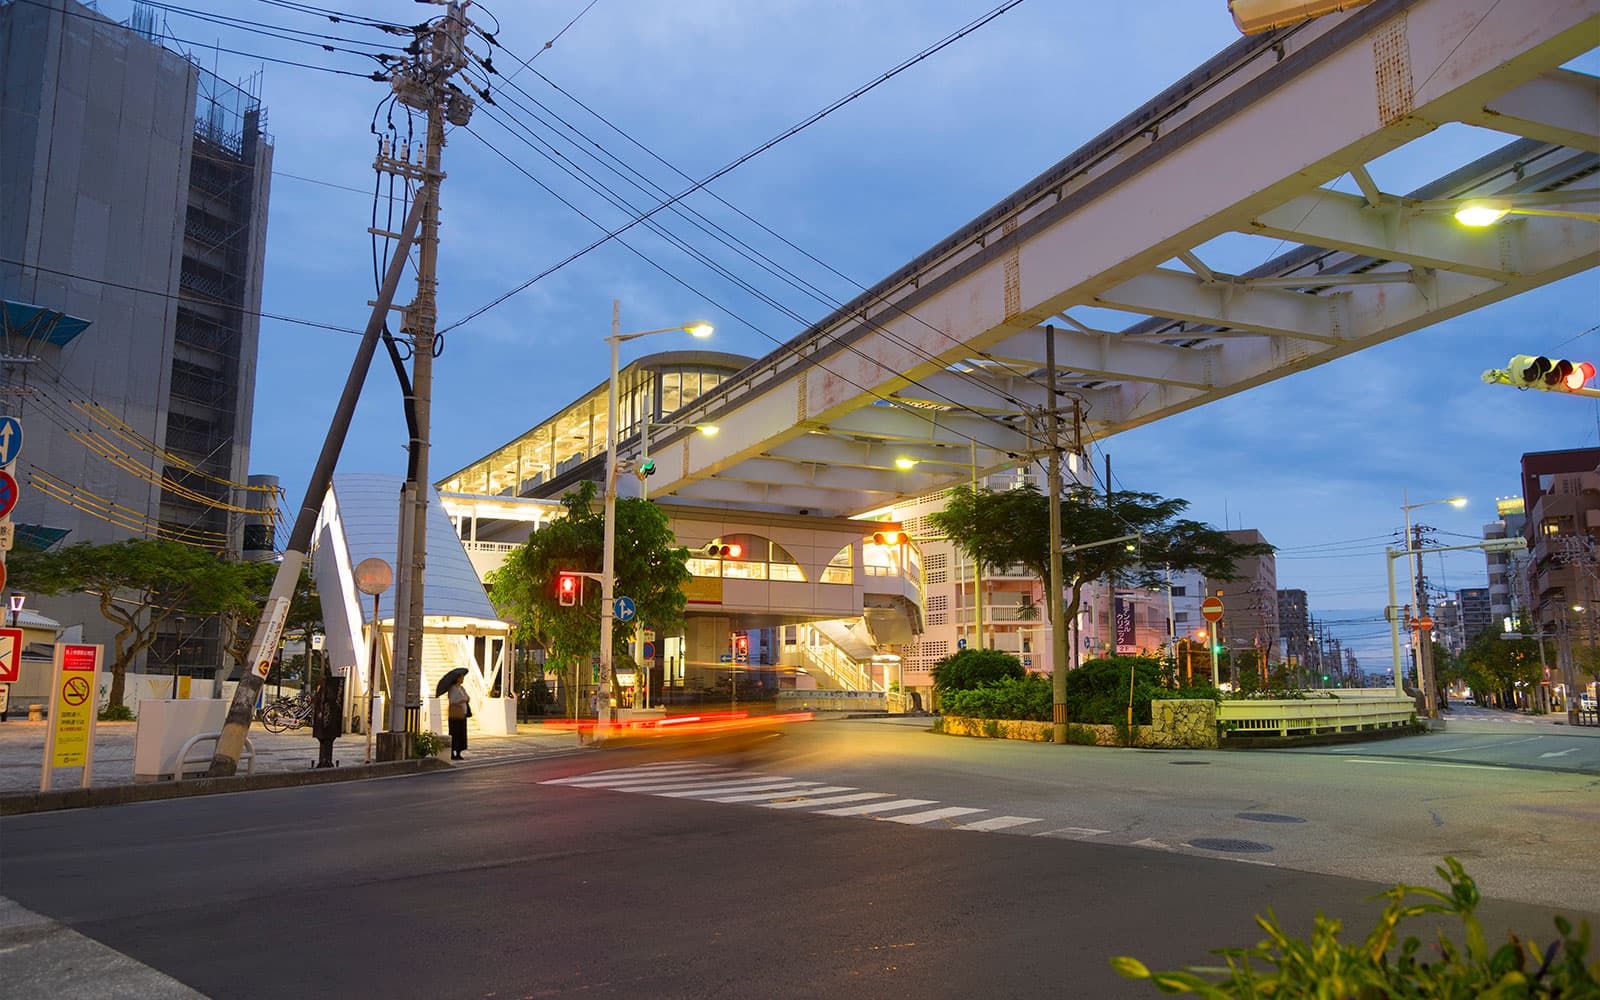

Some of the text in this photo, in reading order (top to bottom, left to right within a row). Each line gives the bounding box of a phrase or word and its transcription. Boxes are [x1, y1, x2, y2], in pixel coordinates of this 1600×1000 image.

[1116, 613, 1124, 644] クリニック
